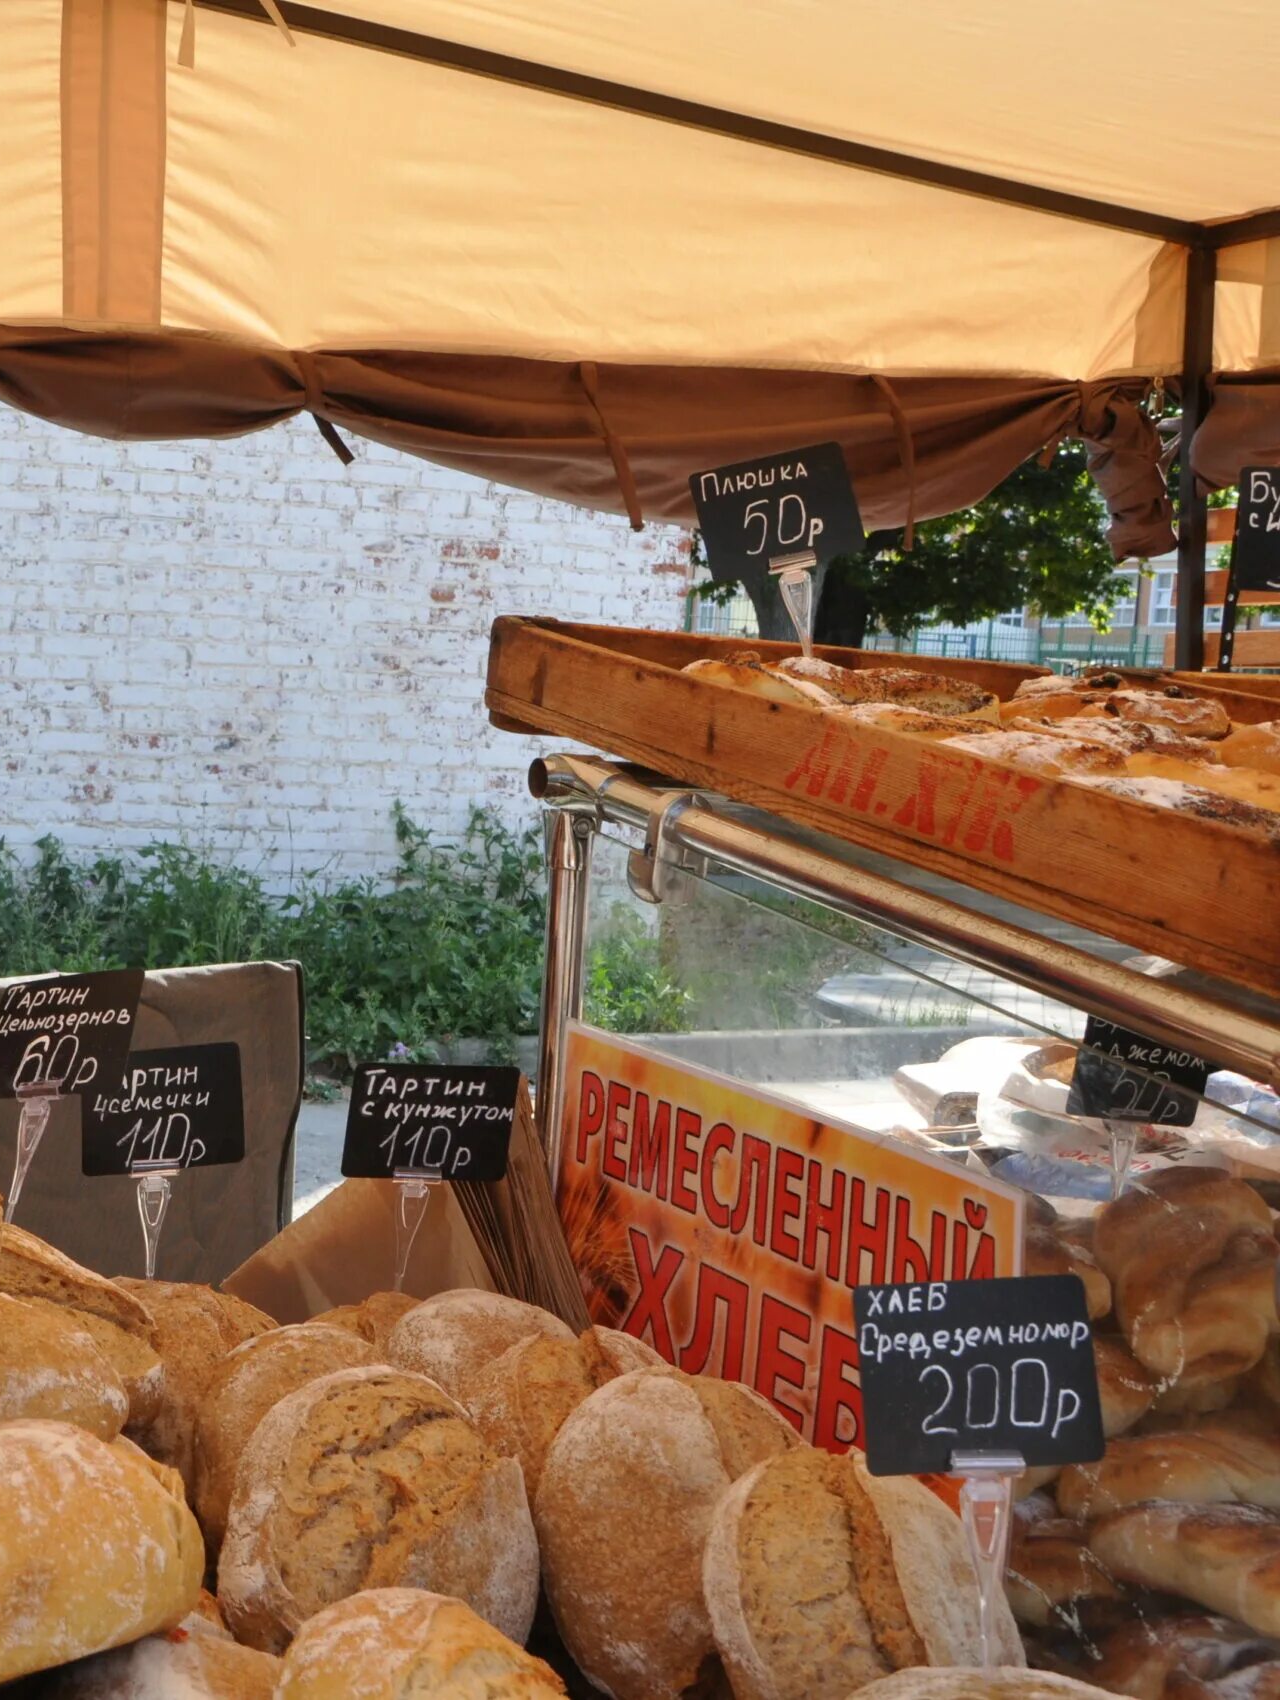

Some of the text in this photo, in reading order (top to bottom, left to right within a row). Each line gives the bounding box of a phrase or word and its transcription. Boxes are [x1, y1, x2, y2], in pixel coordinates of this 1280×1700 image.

[576, 1070, 996, 1289] РЕМЕСЛЕННЫЙ
[621, 1227, 866, 1455] ХЛЕБ
[867, 1282, 948, 1316] ХЛЕБ
